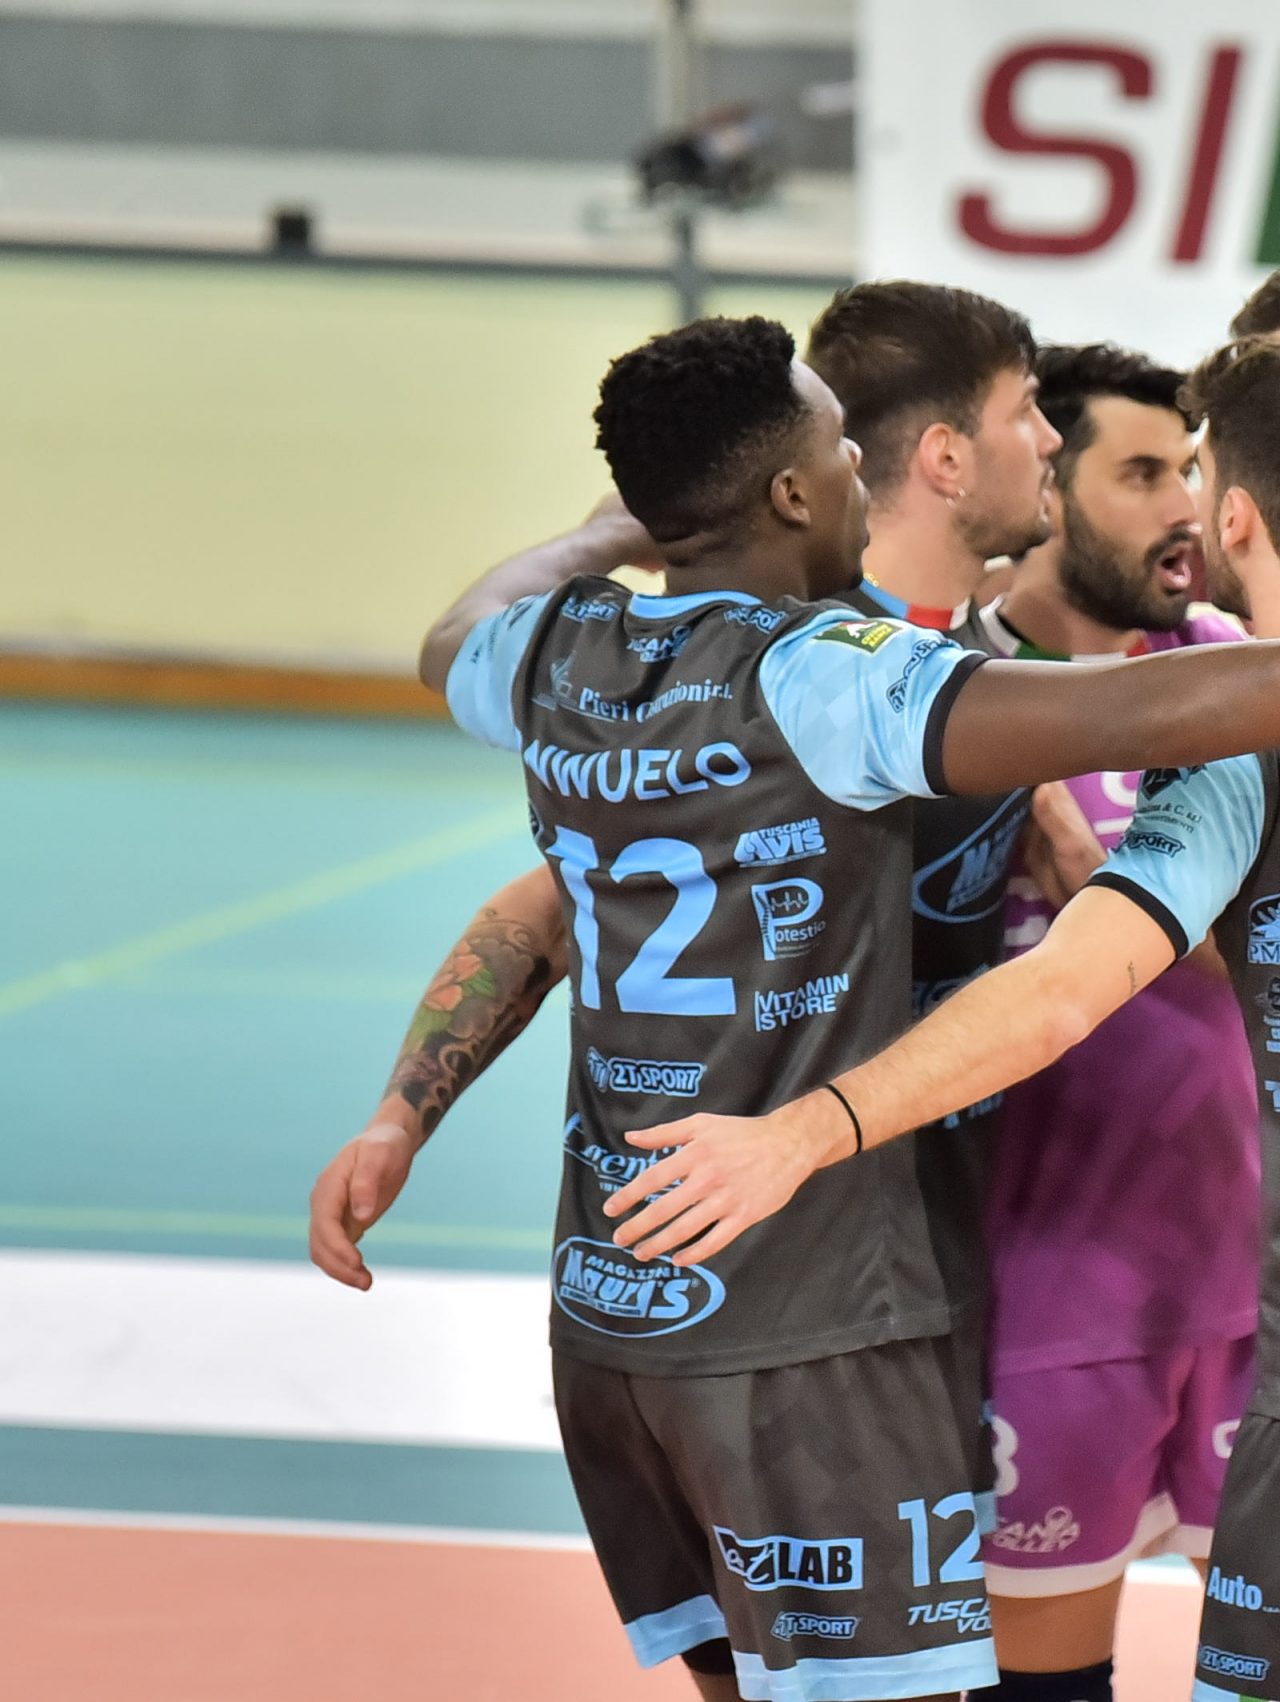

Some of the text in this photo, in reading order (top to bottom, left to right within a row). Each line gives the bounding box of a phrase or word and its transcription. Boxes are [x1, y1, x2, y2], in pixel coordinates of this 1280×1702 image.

[578, 687, 631, 722] Pieri
[733, 828, 826, 864] AVIS
[760, 817, 820, 838] TUSCANIA
[545, 825, 737, 1016] 12
[759, 972, 850, 1012] VITAMIN
[759, 993, 837, 1032] STORE
[612, 1062, 700, 1092] 2T SPORT
[897, 1492, 985, 1588] 12
[778, 1541, 854, 1585] LAB
[1207, 1566, 1263, 1611] Auto
[798, 1617, 854, 1637] SPORT
[1219, 1654, 1265, 1676] SPORT
